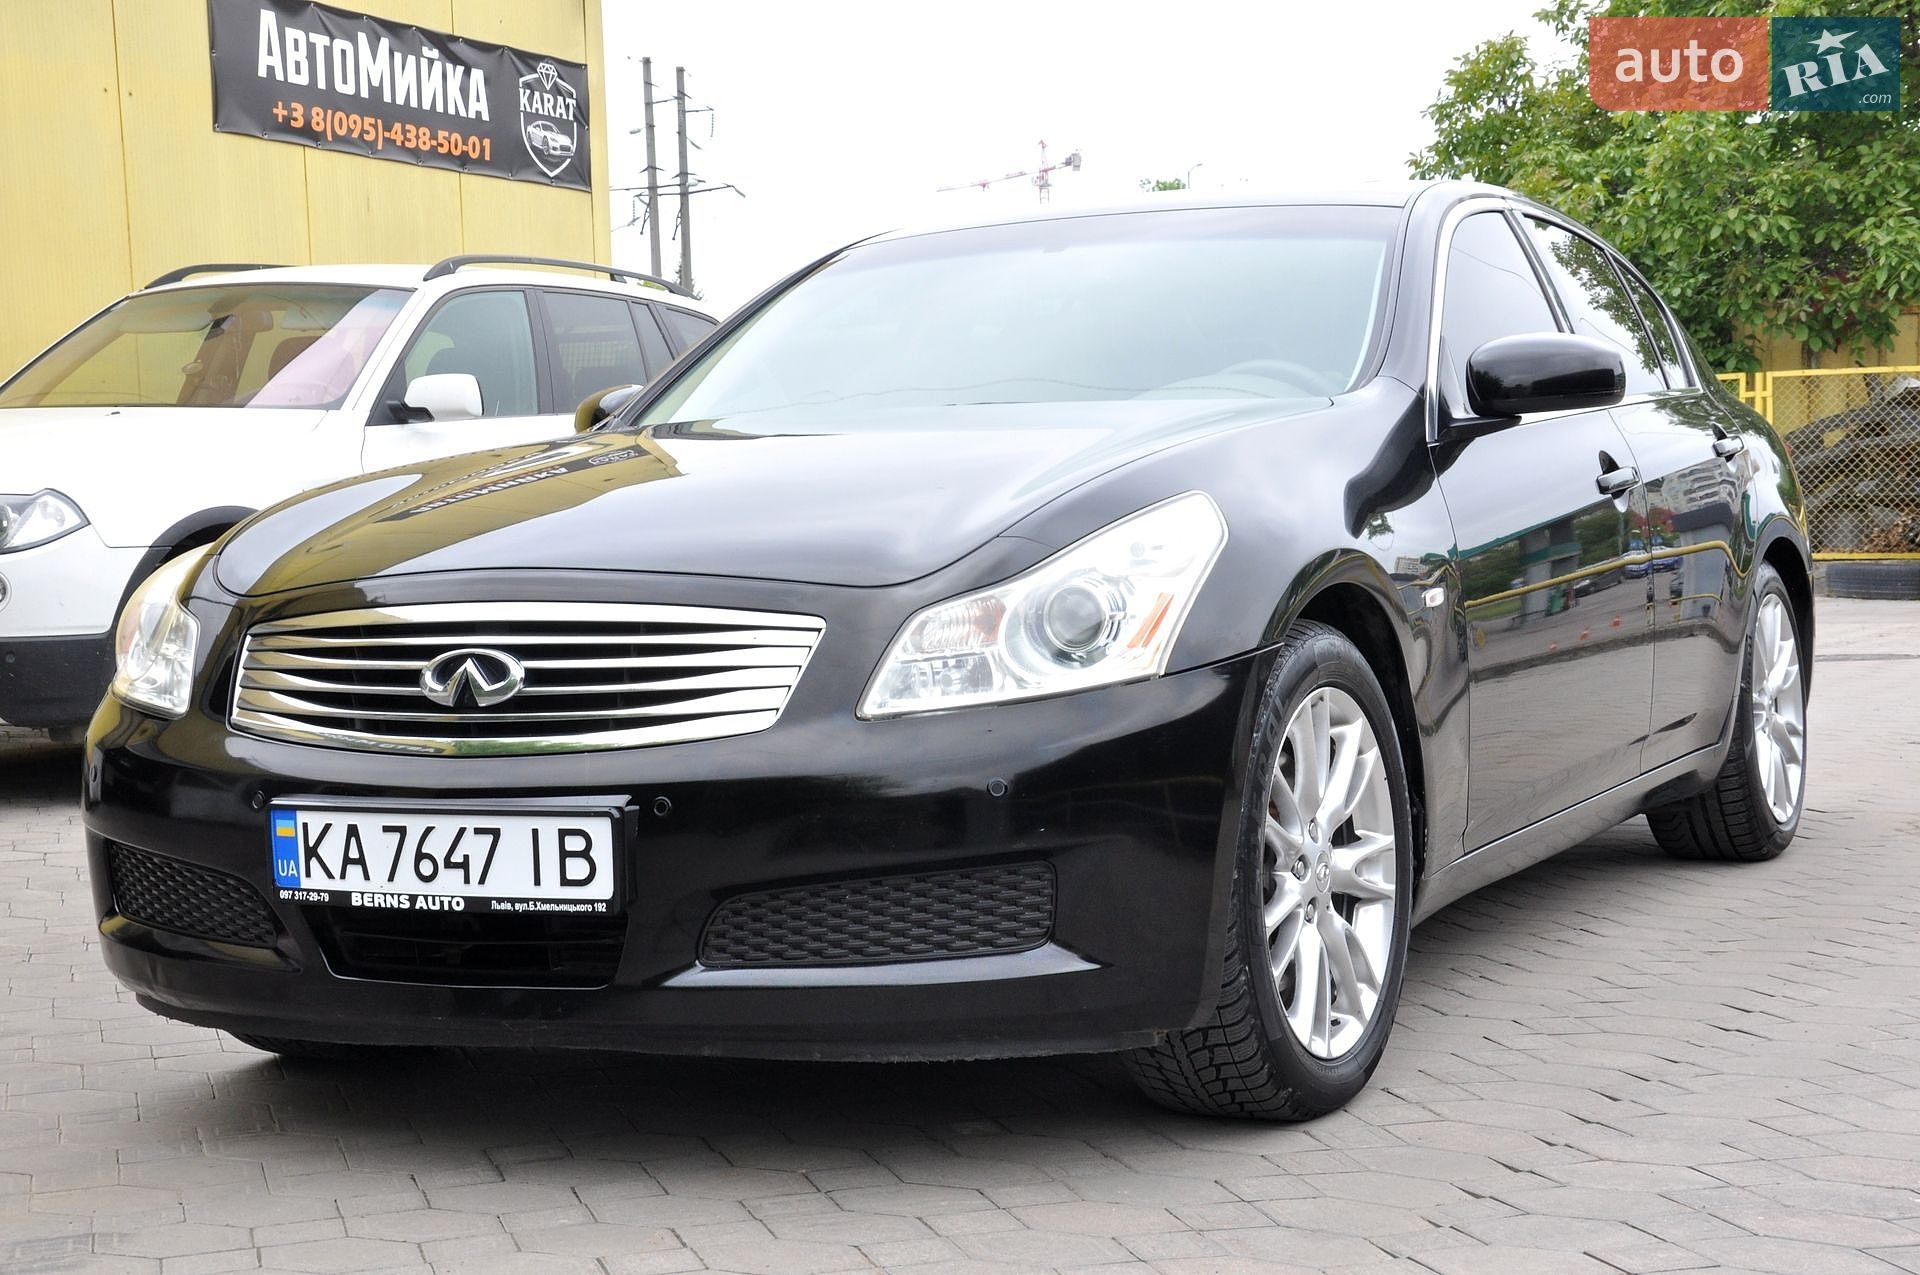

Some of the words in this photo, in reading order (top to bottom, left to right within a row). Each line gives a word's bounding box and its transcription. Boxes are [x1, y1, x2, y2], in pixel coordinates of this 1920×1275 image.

[519, 87, 576, 121] KARAT
[272, 101, 305, 128] +3
[311, 106, 491, 161] 8(095)-438-50-01
[278, 858, 298, 877] UA
[279, 889, 292, 900] 097
[293, 891, 330, 902] 317-29-79
[351, 892, 411, 909] BERNS
[415, 896, 465, 911] AUTO
[593, 902, 607, 912] 192
